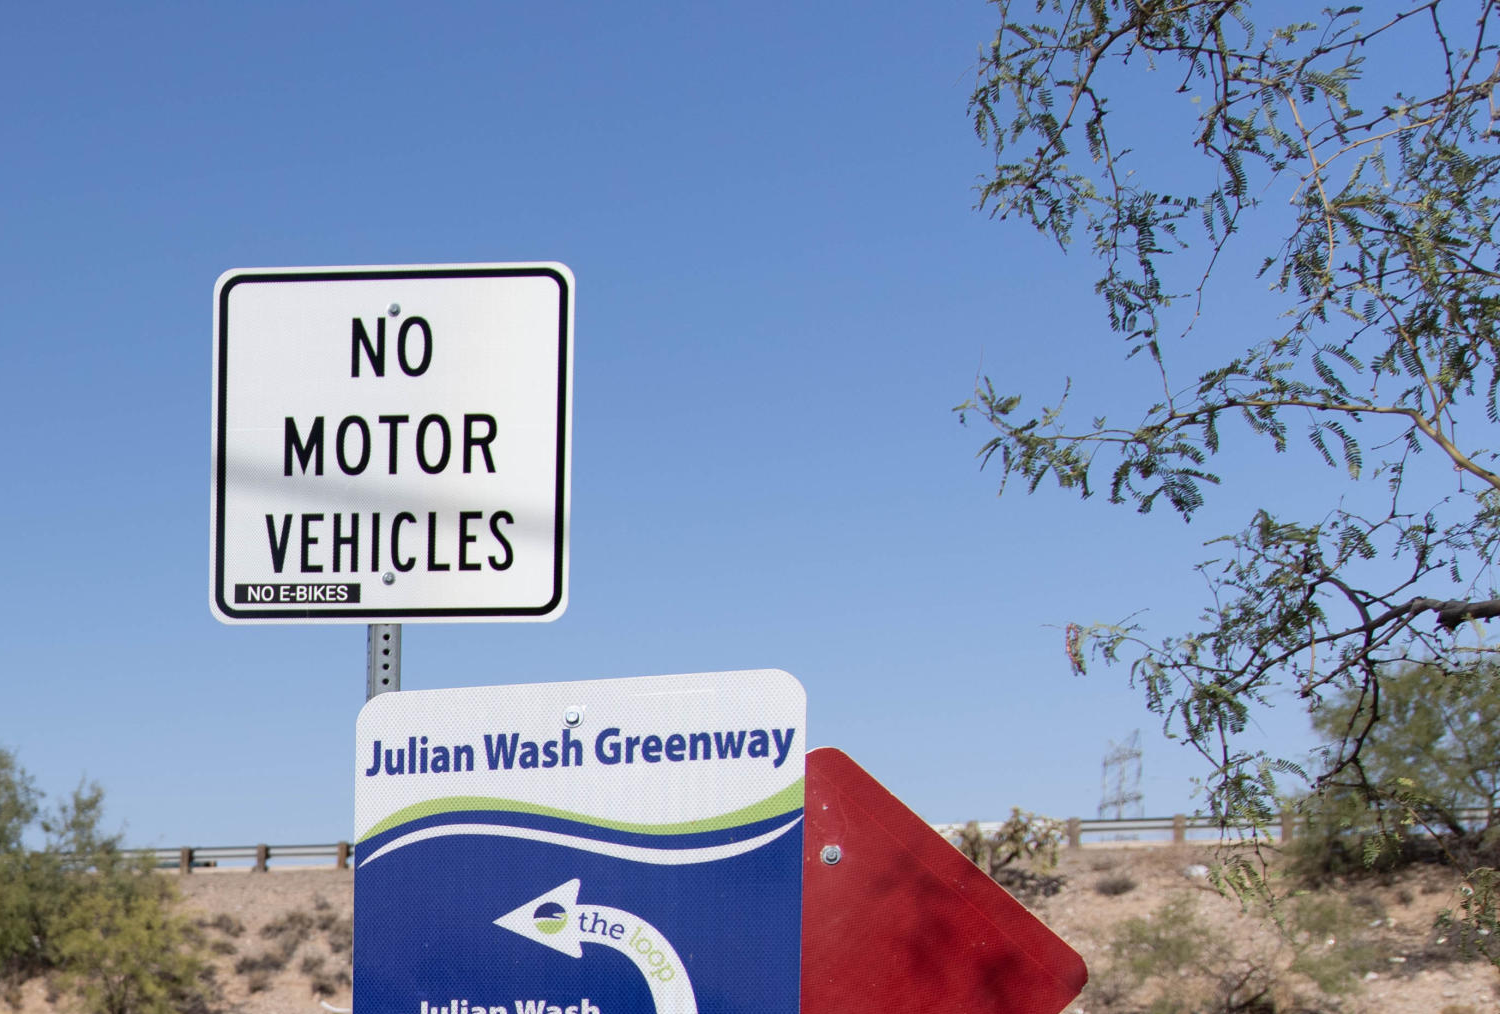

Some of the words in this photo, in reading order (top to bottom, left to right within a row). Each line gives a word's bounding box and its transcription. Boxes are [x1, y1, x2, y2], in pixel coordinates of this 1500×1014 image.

[350, 315, 433, 378] NO
[283, 413, 498, 476] MOTOR
[264, 510, 515, 574] VEHICLES
[247, 586, 275, 602] NO
[279, 584, 349, 601] E-BIKES
[365, 737, 475, 777] Julian
[484, 728, 583, 771] Wash
[594, 726, 796, 768] Greenway
[578, 911, 625, 940] the
[628, 926, 676, 982] loop
